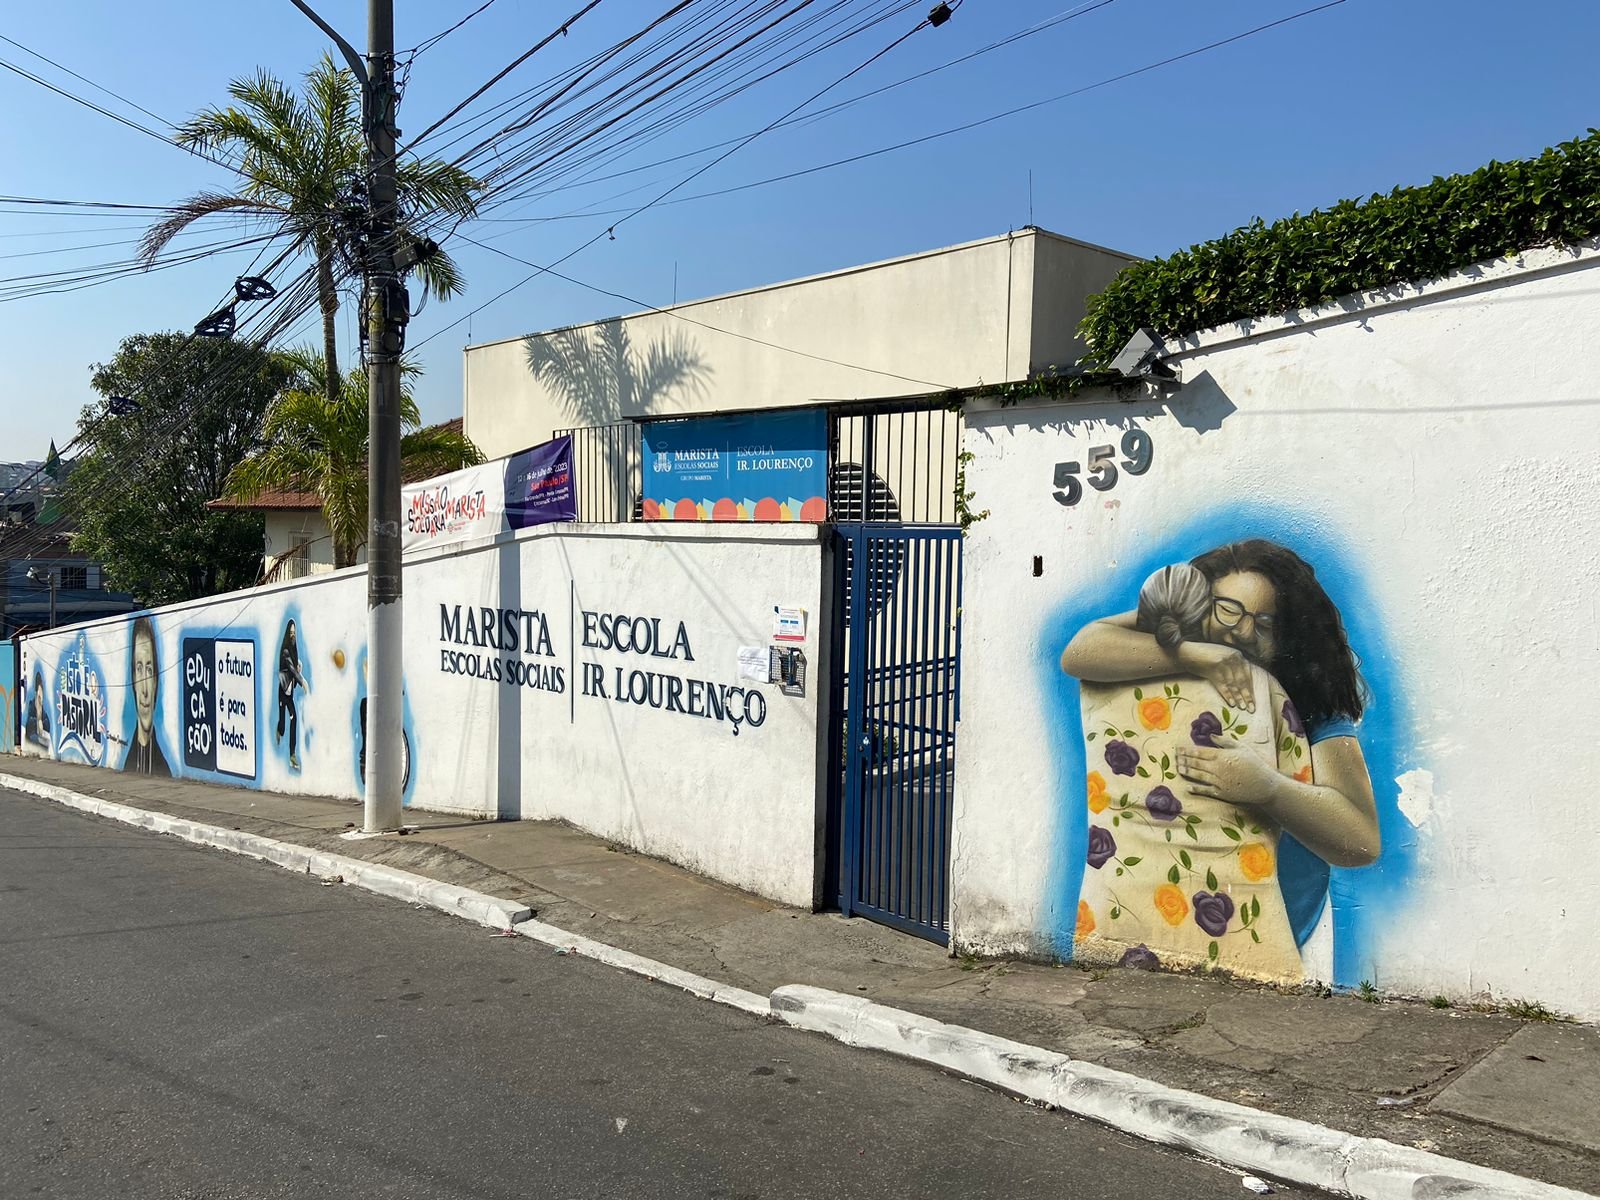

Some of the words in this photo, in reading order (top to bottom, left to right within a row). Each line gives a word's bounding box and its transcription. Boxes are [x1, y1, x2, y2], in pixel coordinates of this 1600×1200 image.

[674, 448, 719, 461] MARISTA
[697, 461, 719, 469] SOCIAIS
[736, 444, 774, 457] ESCOLA
[736, 459, 750, 471] IR.
[752, 457, 813, 472] LOURENÇO
[554, 462, 567, 472] 2023
[1052, 428, 1154, 507] 559
[413, 486, 448, 515] MISSÃO
[445, 490, 486, 520] MARISTA
[439, 603, 556, 657] MARISTA
[581, 610, 696, 662] ESCOLA
[218, 659, 224, 674] o
[225, 651, 252, 678] futuro
[440, 649, 502, 682] ESCOLAS
[506, 659, 566, 694] SOCIAIS
[190, 690, 206, 719] CA
[219, 691, 225, 713] é
[227, 698, 246, 719] para
[582, 662, 612, 700] IR.
[615, 667, 767, 736] LOURENÇO
[62, 693, 101, 743] PASTORAL
[220, 722, 248, 751] todos.
